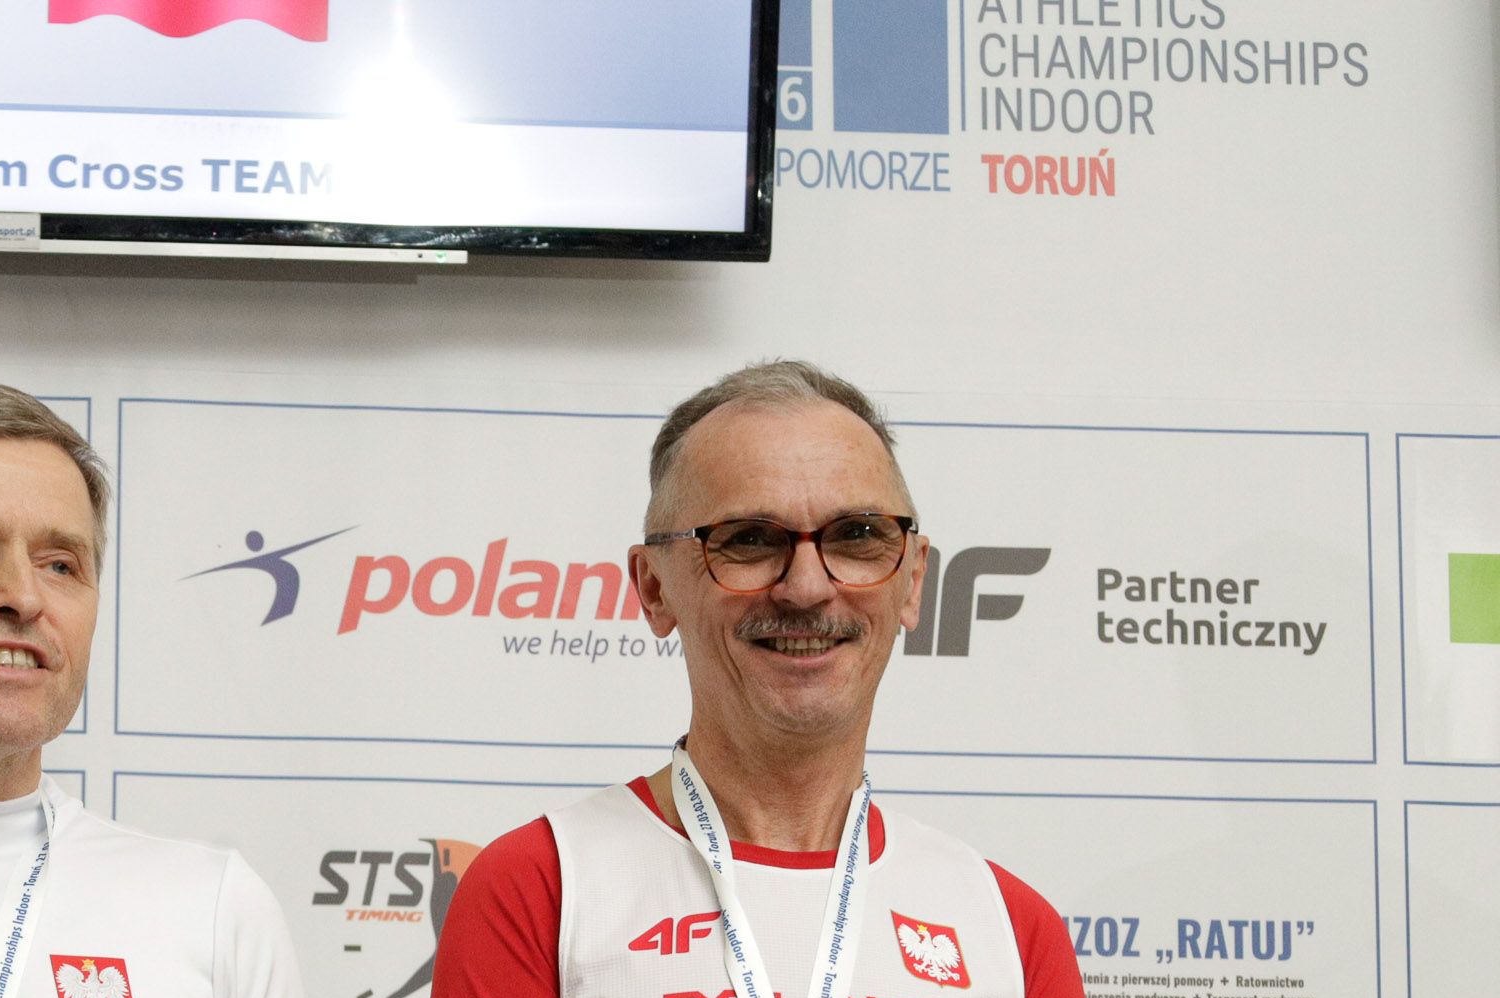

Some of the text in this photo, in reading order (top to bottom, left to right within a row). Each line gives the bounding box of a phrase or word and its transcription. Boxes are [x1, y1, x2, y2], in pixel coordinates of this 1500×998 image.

[978, 33, 1370, 88] CHAMPIONSHIPS
[980, 87, 1155, 135] INDOOR
[47, 154, 184, 191] Cross
[201, 158, 333, 195] TEAM
[775, 147, 1116, 197] POMORZE TORUŃ
[1097, 567, 1259, 605] Partner
[503, 634, 541, 656] we
[550, 630, 609, 663] help
[619, 634, 646, 656] to
[1097, 609, 1327, 656] techniczny
[678, 768, 710, 831] 27.03-02.04.2026
[852, 812, 864, 843] Masters
[312, 850, 431, 907] STS
[845, 841, 859, 880] Athletics
[13, 892, 31, 925] Indoor
[345, 909, 424, 923] TIMING
[834, 878, 854, 933] Championships
[628, 911, 723, 955] 4F
[726, 926, 746, 963] Indoor
[828, 933, 845, 965] Indoor
[1068, 916, 1140, 958] ZOZ
[1083, 973, 1110, 985] lenia
[1113, 975, 1119, 985] z
[1122, 973, 1171, 988] pierwszej
[1174, 976, 1214, 990] pomocy
[1236, 975, 1305, 989] Ratownictwo
